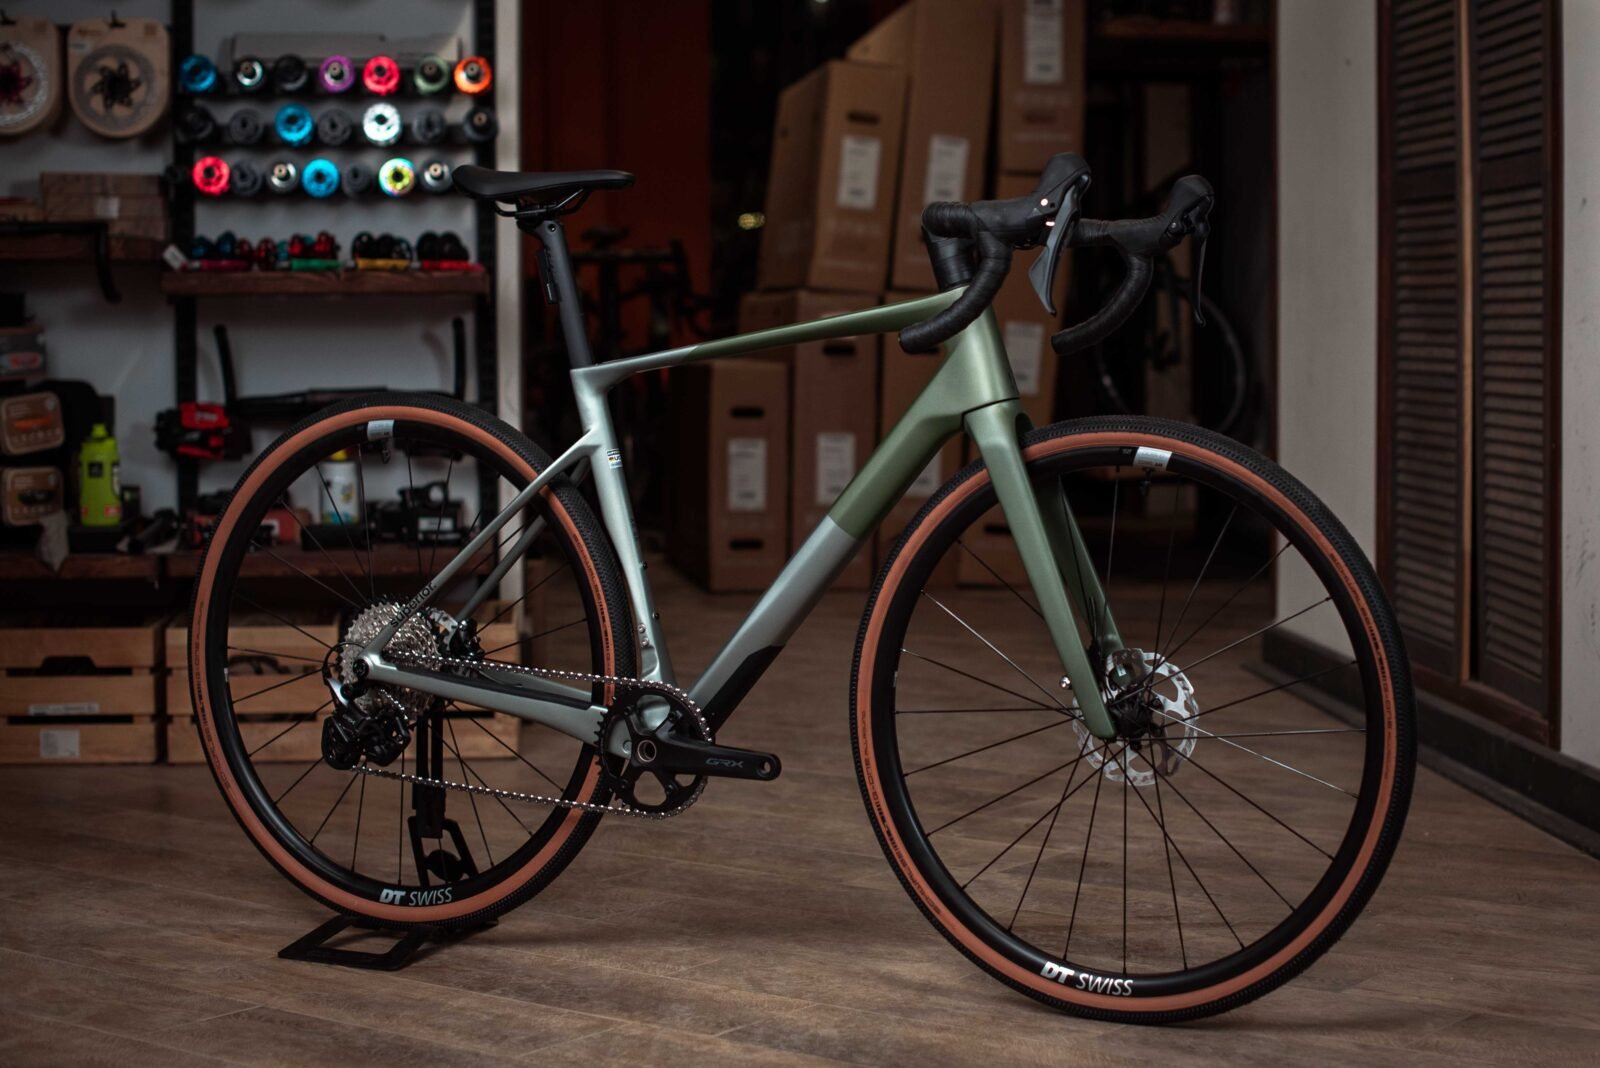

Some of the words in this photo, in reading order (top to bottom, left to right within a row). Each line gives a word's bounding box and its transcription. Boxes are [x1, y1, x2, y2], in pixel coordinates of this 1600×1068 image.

[705, 757, 745, 769] GRX
[379, 888, 406, 905] DT
[409, 887, 453, 906] SWISS
[1040, 961, 1075, 983] DT
[1076, 973, 1134, 996] SWISS
